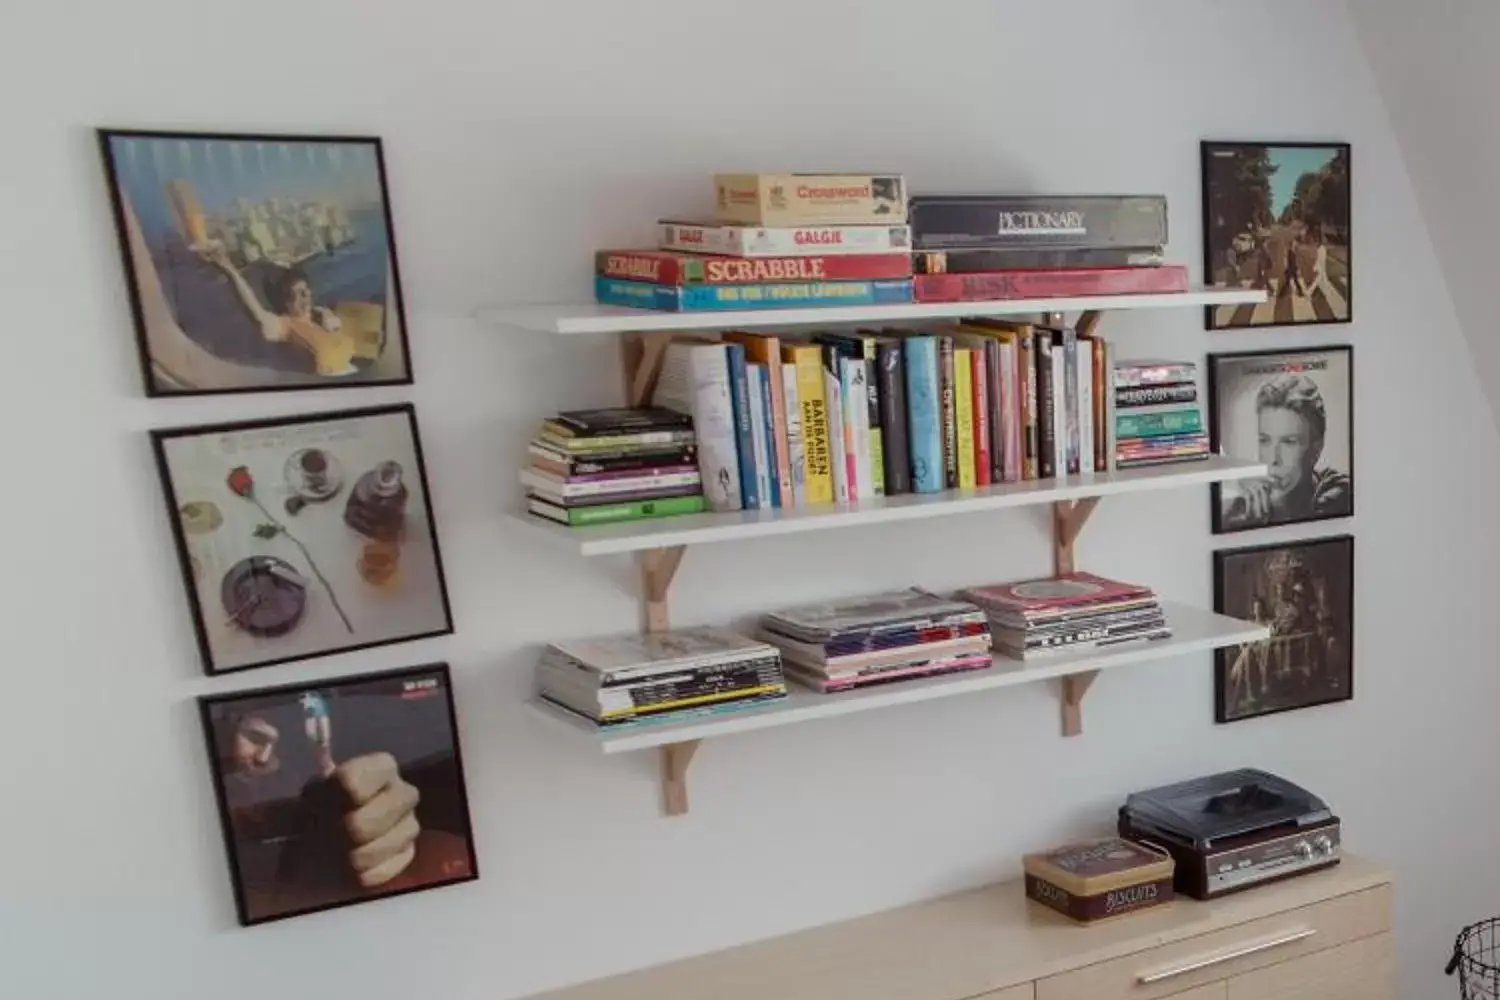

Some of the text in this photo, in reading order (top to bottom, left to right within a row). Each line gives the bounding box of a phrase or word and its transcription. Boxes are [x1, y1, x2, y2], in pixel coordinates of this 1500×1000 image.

[999, 211, 1086, 229] PICTIONARY
[707, 257, 825, 281] SCRABBLE
[811, 399, 829, 476] BARBAREN
